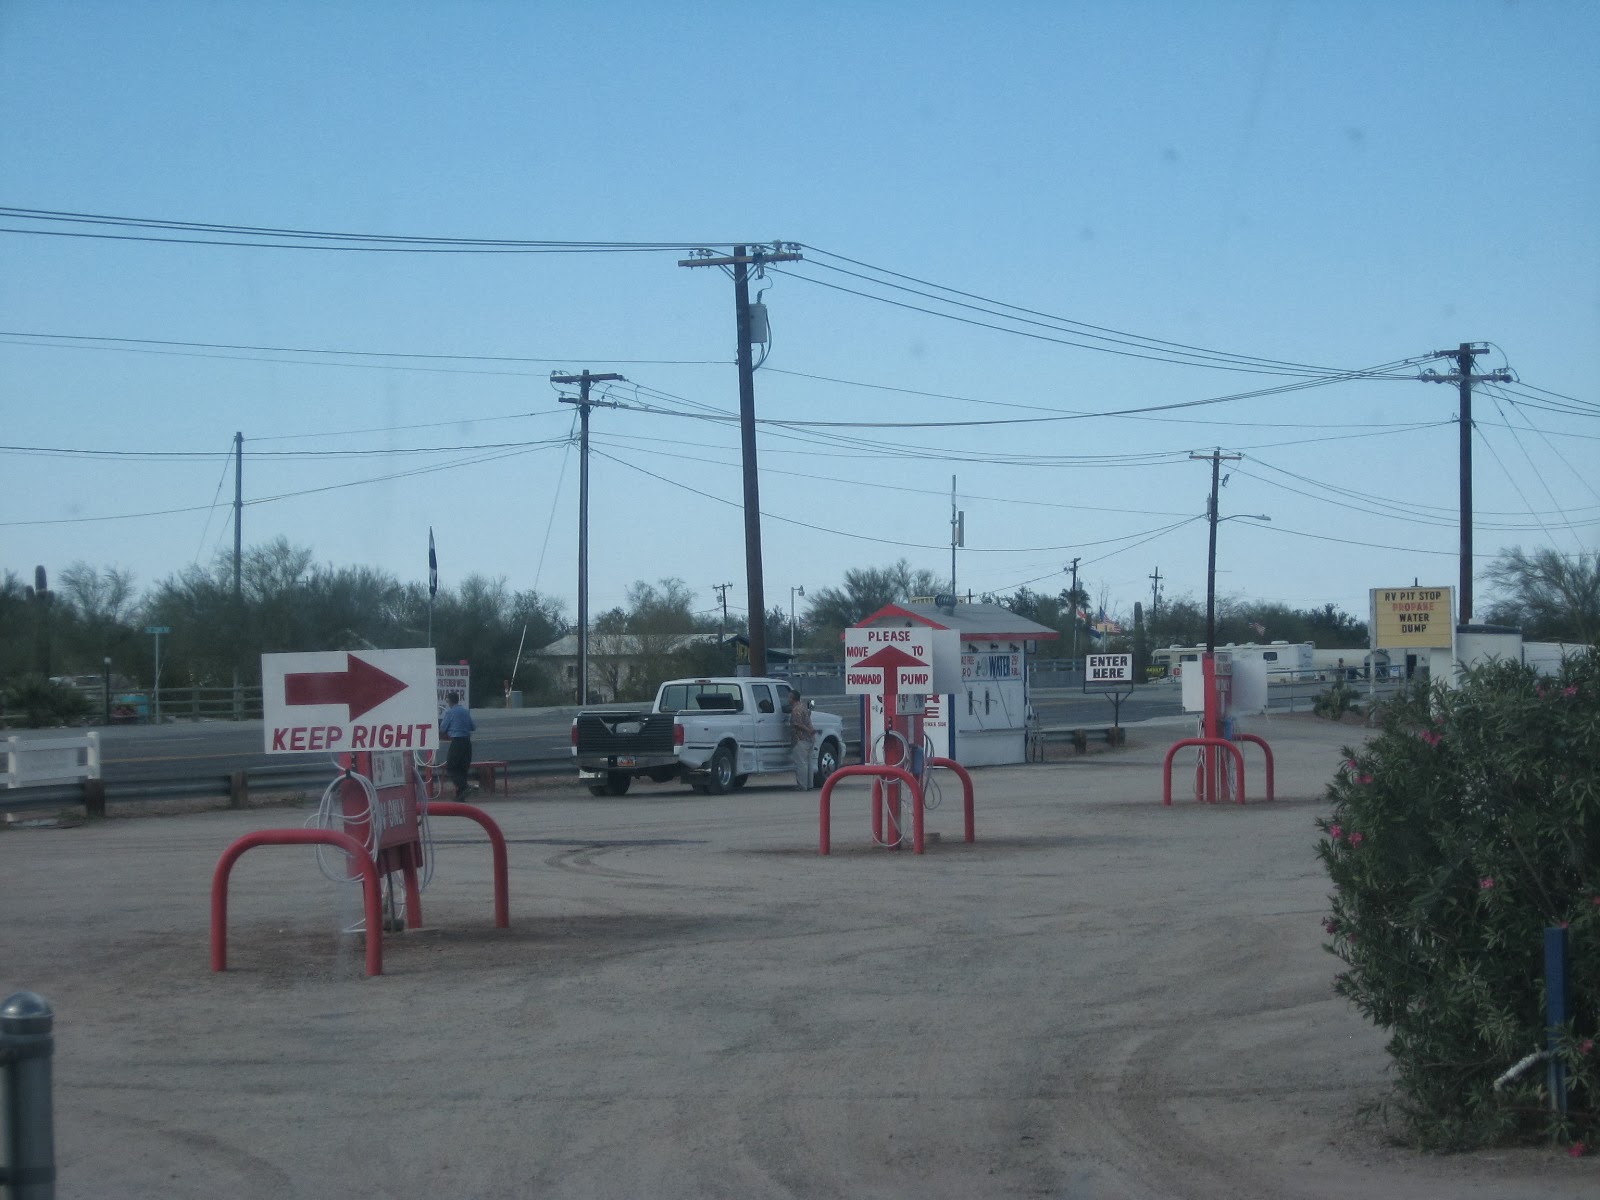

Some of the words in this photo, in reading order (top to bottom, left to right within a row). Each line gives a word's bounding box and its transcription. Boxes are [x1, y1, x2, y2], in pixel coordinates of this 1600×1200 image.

[1385, 592, 1397, 601] RV
[1400, 592, 1415, 601] PIT
[1419, 591, 1441, 601] STOP
[1392, 602, 1435, 612] PROPANE
[1399, 613, 1430, 622] WATER
[1402, 624, 1427, 633] DUMP
[868, 630, 911, 642] PLEASE
[846, 646, 869, 658] MOVE
[912, 646, 923, 656] TO
[989, 655, 1011, 678] WATER
[1090, 656, 1128, 667] ENTER
[847, 673, 882, 685] FORWARD
[900, 673, 929, 685] PUMP
[1093, 667, 1125, 679] HERE
[437, 689, 465, 702] WAR
[273, 726, 342, 750] KEEP
[351, 724, 432, 748] RIGHT
